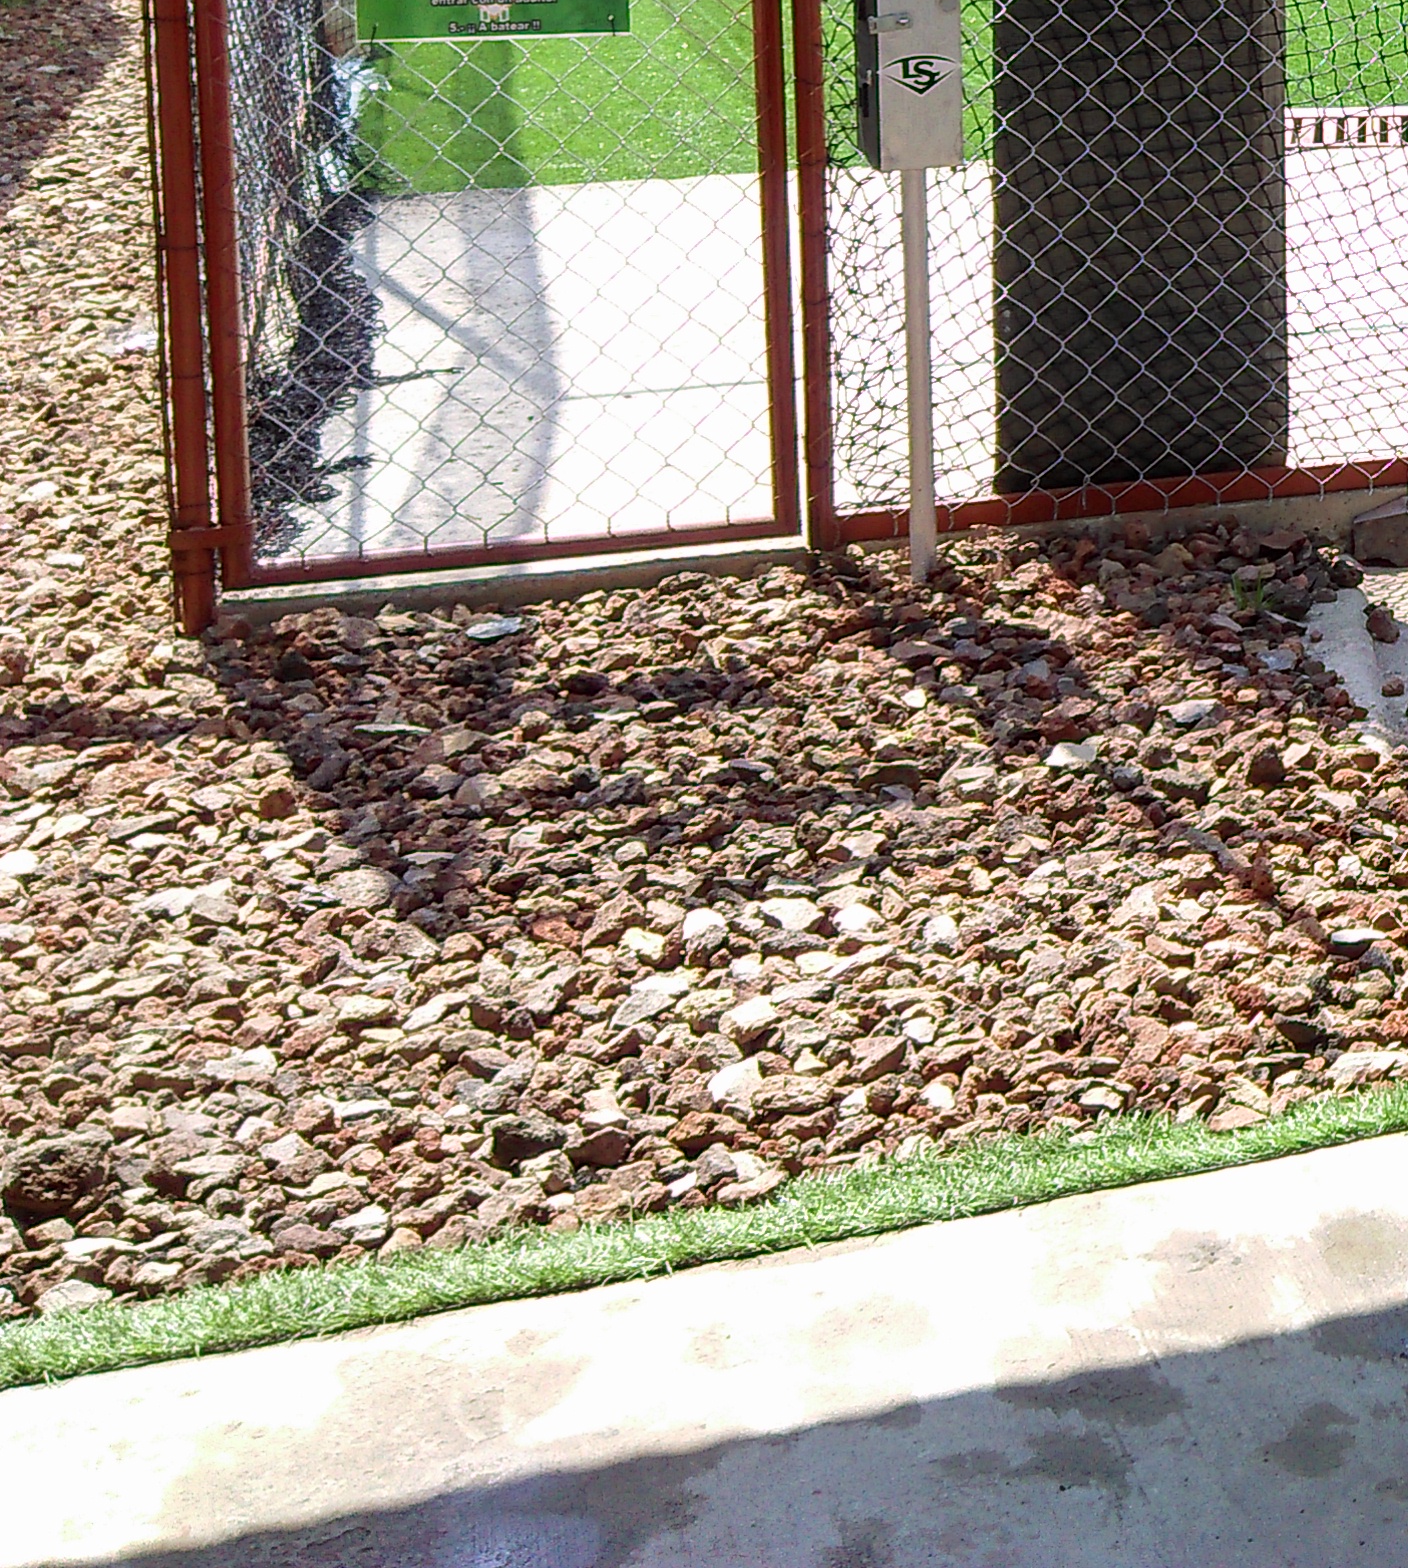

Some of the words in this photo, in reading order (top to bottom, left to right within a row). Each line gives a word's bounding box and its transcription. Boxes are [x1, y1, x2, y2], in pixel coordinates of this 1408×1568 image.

[479, 23, 487, 31] A
[491, 21, 529, 31] batear
[902, 59, 941, 86] LS
